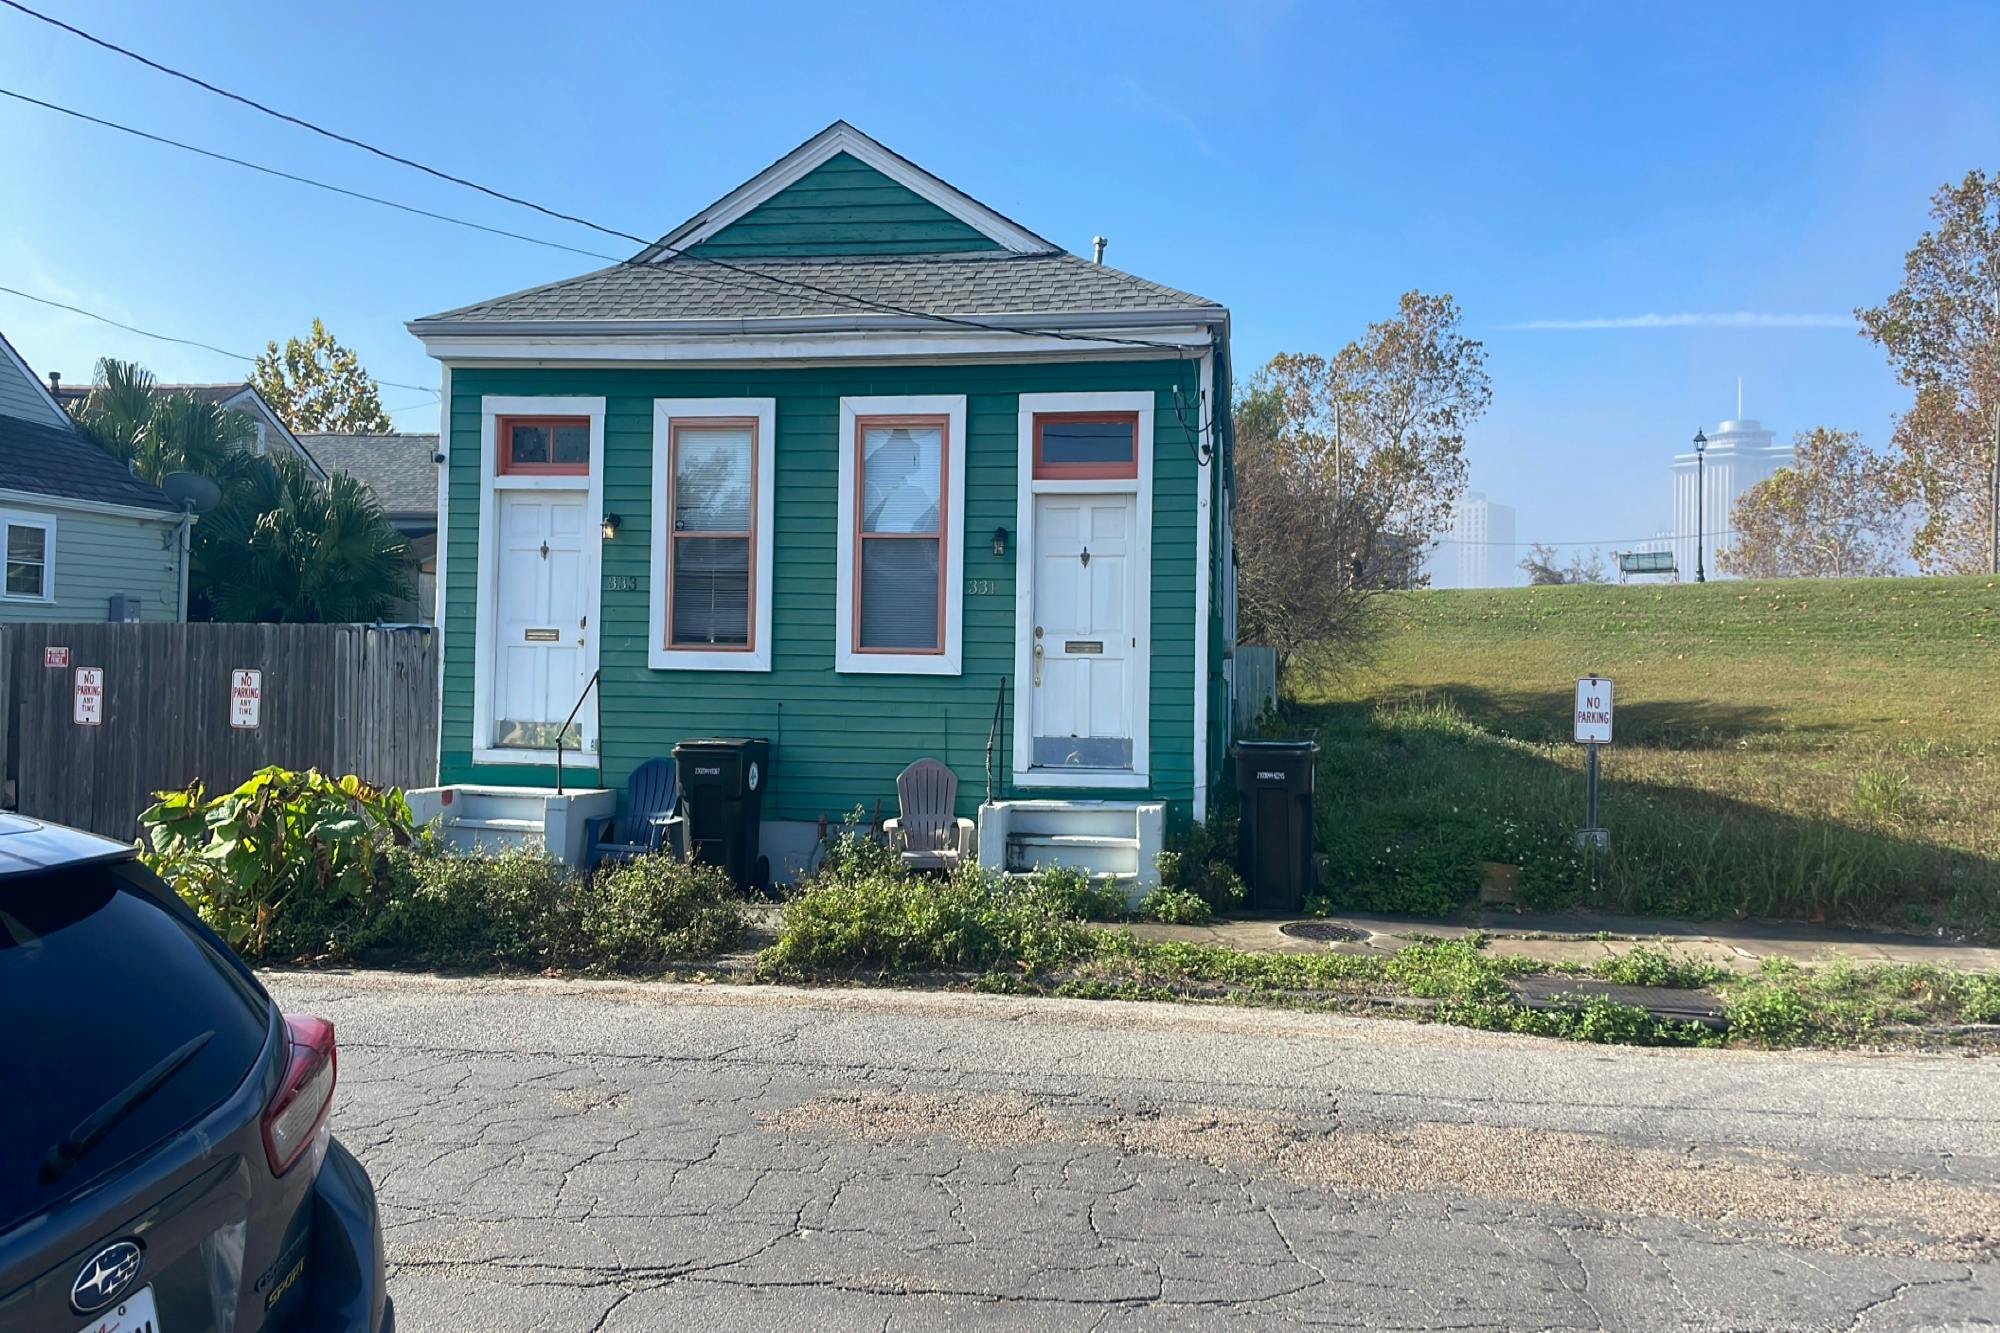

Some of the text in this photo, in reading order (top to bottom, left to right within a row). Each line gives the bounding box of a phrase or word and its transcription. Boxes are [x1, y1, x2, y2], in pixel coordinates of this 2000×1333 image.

[608, 576, 638, 591] 333
[969, 580, 995, 594] 331
[84, 673, 95, 685] NO
[241, 676, 252, 687] NO
[77, 685, 100, 696] PARKING
[233, 687, 259, 698] PARKING
[1586, 696, 1600, 709] NO
[239, 707, 252, 715] TIME
[1577, 711, 1609, 724] PARKING
[268, 1254, 306, 1309] SPORT
